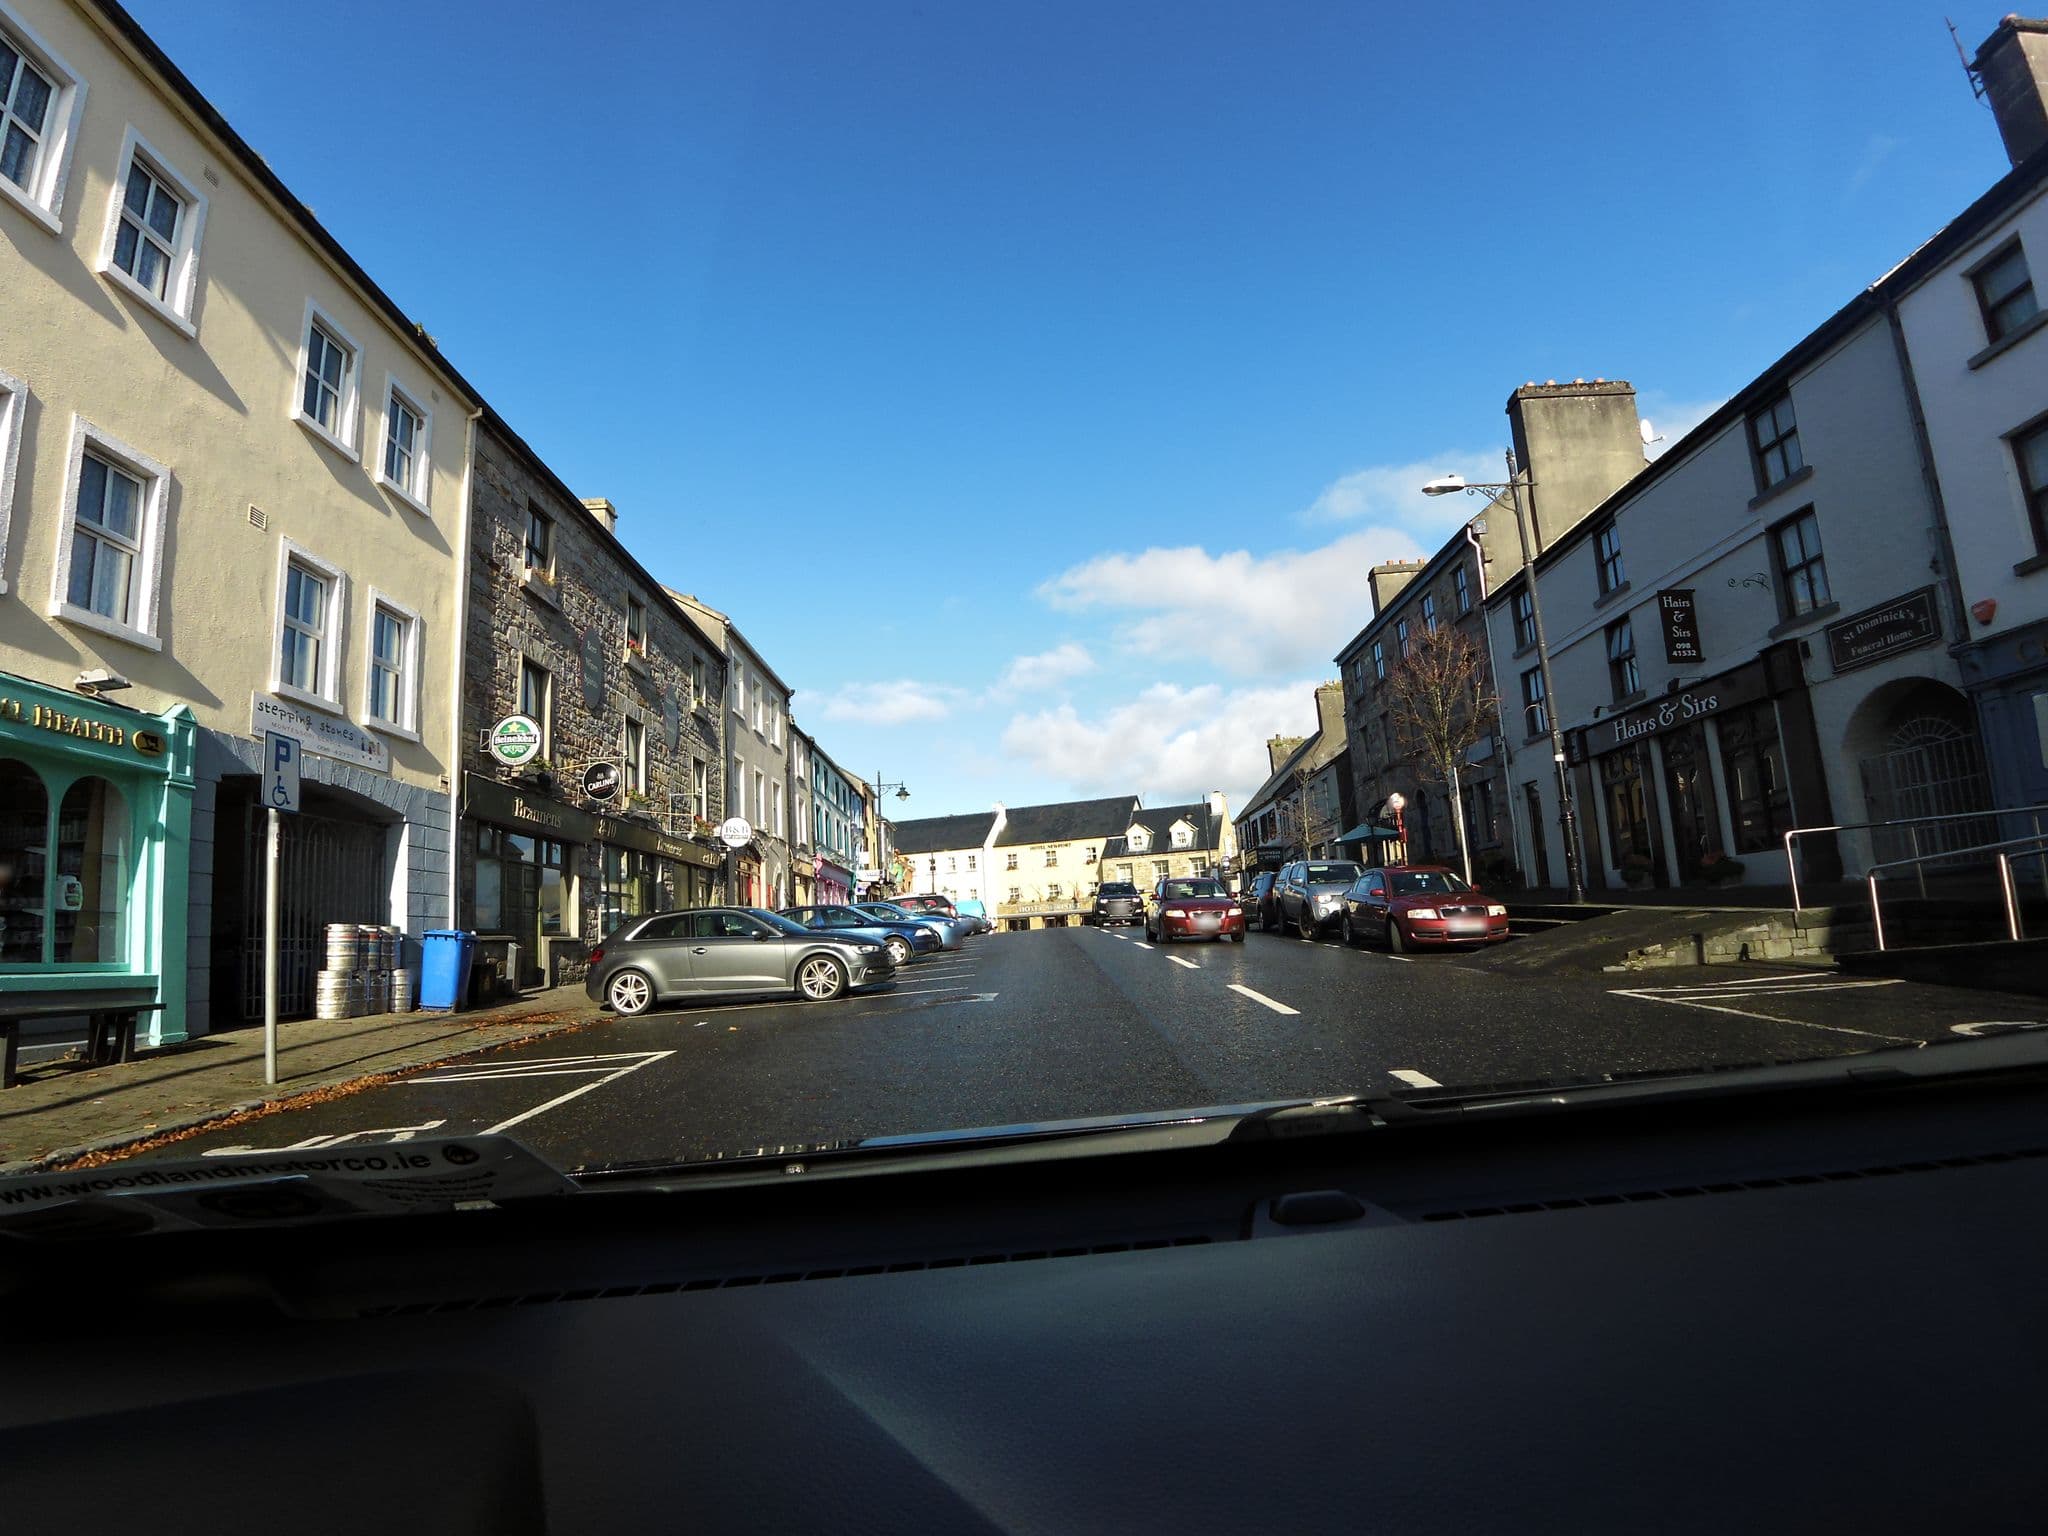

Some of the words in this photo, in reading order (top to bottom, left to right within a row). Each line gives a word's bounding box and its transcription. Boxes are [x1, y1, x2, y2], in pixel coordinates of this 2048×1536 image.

[1662, 596, 1691, 608] Hairs
[1673, 611, 1686, 622] &
[1672, 625, 1691, 638] Sirs
[1851, 637, 1885, 656] Funeral
[1887, 630, 1913, 645] Home
[33, 704, 125, 745] HEALTH
[257, 701, 312, 731] stepping
[319, 718, 354, 741] stones
[1613, 716, 1657, 743] Hairs
[1659, 702, 1679, 726] &
[1681, 694, 1718, 719] Sirs
[494, 733, 537, 745] Heineken
[274, 738, 291, 772] P
[587, 778, 615, 792] CARLING
